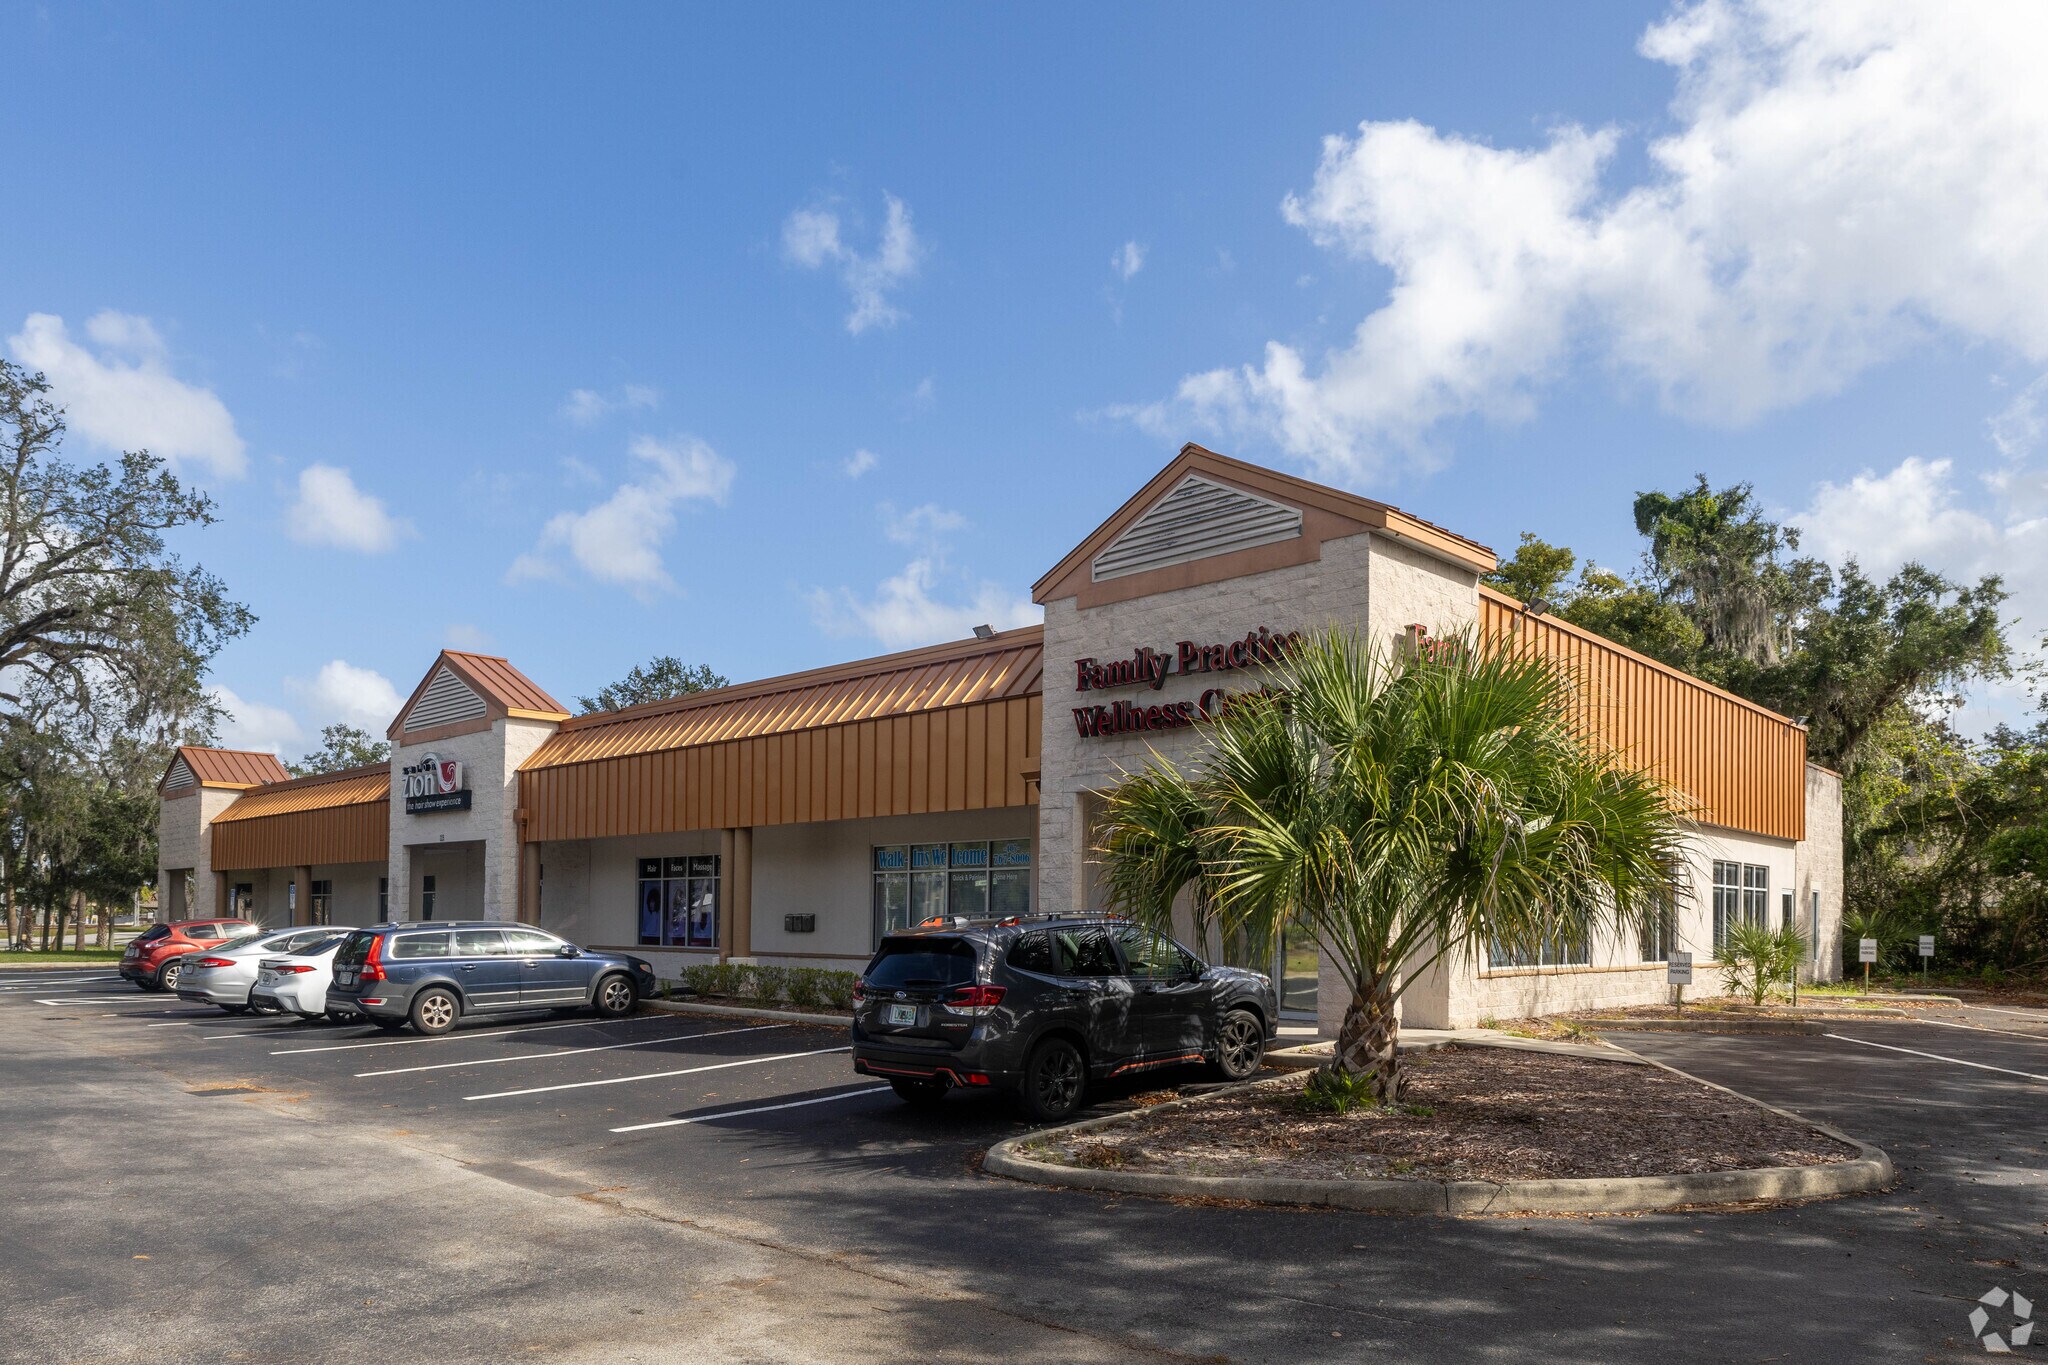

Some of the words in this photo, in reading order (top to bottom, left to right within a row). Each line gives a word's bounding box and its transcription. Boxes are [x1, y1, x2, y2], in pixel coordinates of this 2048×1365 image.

[1074, 646, 1171, 692] Family
[1072, 700, 1192, 738] Wellness
[436, 798, 461, 808] experience
[647, 864, 657, 873] Hair
